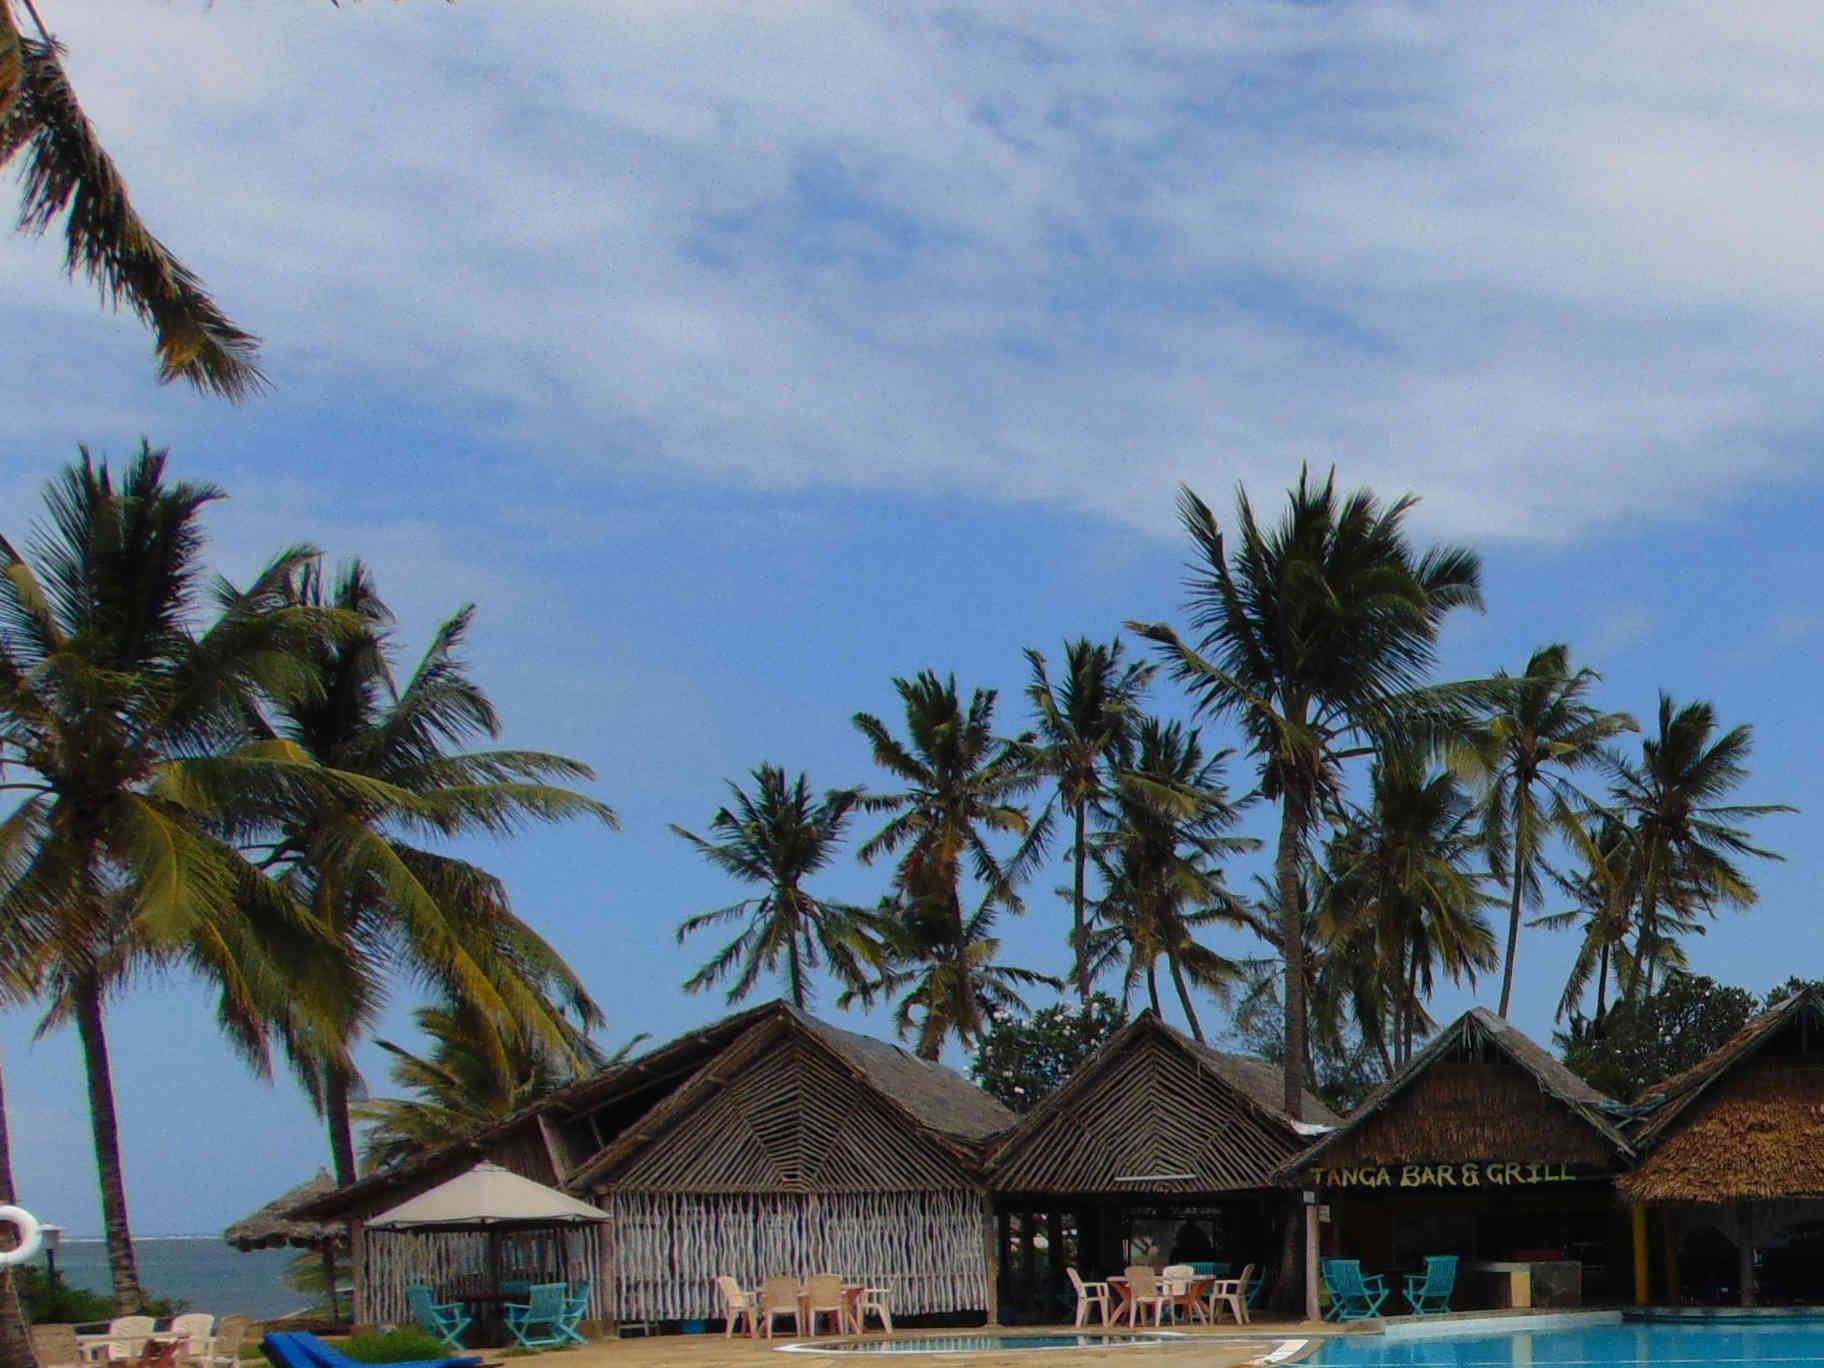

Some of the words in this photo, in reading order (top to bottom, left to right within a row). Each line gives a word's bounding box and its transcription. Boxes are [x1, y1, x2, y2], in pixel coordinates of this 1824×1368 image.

[1311, 1166, 1391, 1188] TANGA
[1400, 1164, 1457, 1187] BAR
[1462, 1162, 1480, 1187] &
[1486, 1161, 1577, 1186] GRILL
